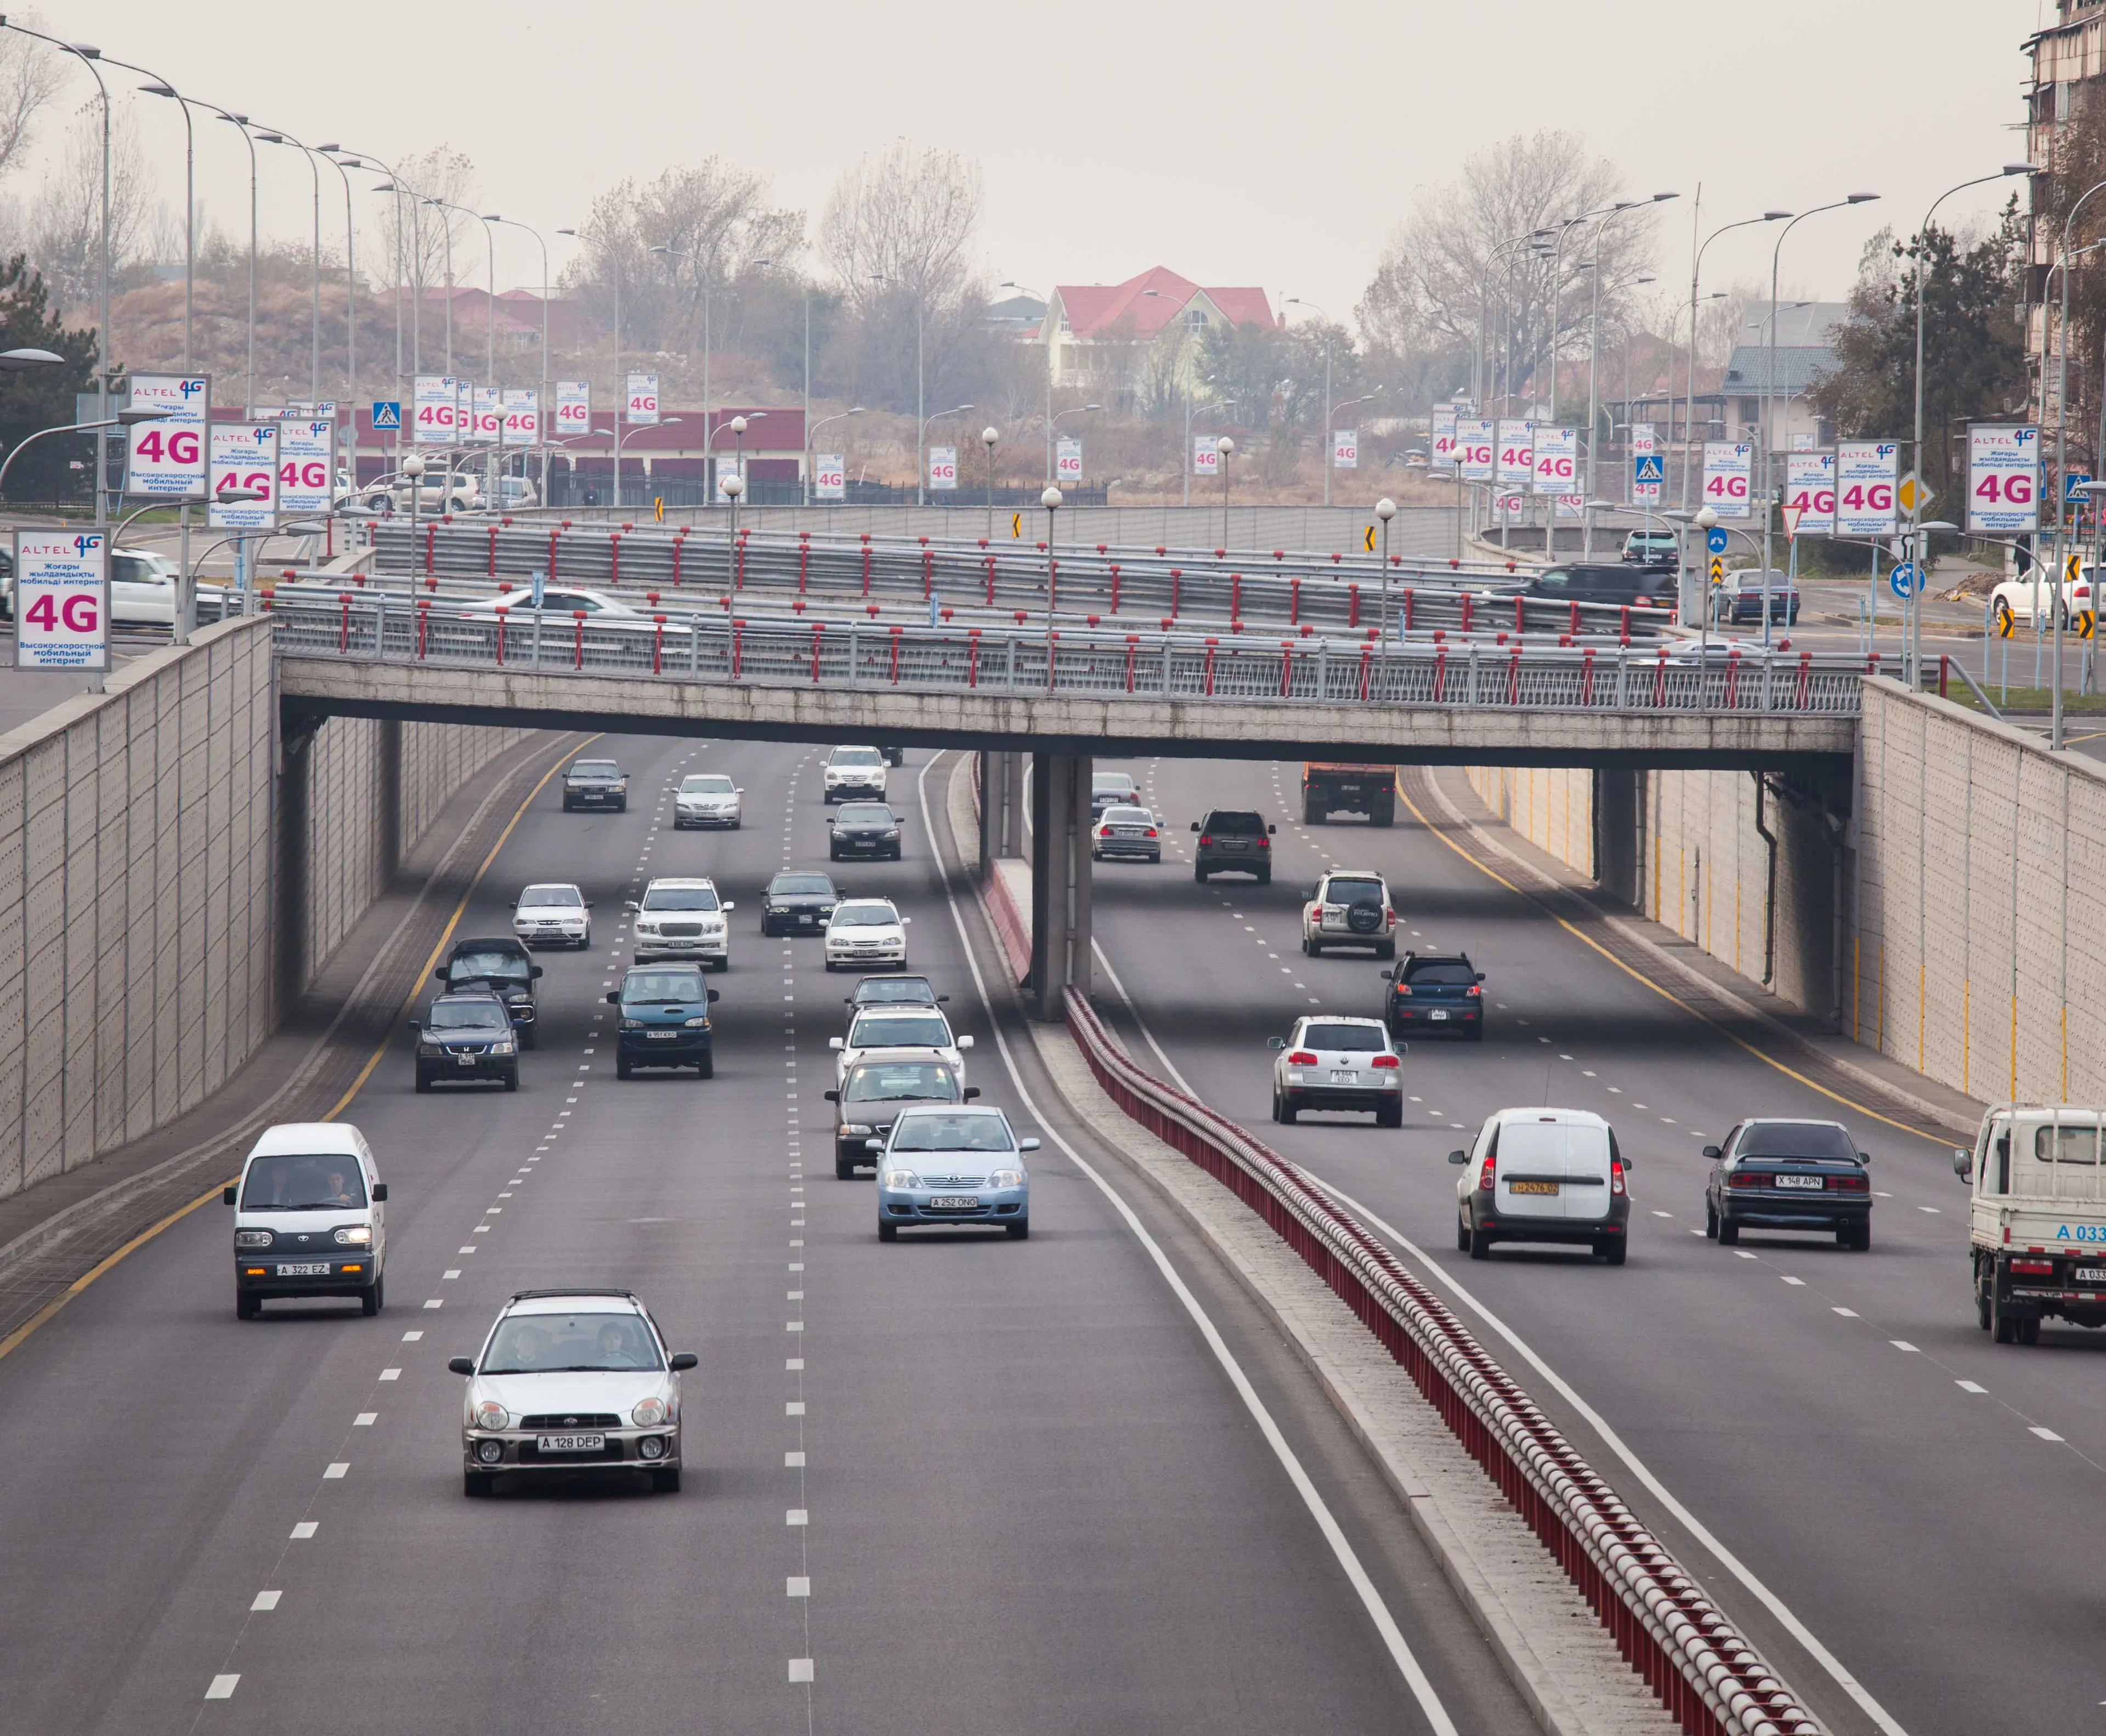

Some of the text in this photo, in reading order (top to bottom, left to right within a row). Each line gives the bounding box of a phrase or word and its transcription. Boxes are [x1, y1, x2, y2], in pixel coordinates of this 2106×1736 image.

[179, 380, 205, 400] 4G
[441, 378, 456, 389] 4G
[318, 403, 334, 415] 4G
[631, 397, 656, 410] 4G
[418, 406, 453, 425] 4G
[458, 410, 468, 427] G
[559, 405, 586, 419] 4G
[506, 415, 535, 430] 4G
[253, 428, 275, 445] 4G
[1561, 430, 1575, 441] 4G
[2014, 430, 2036, 447] 4G
[137, 431, 199, 464] 4G
[1436, 438, 1454, 452] 4
[1635, 440, 1652, 450] 4G
[1196, 453, 1215, 464] 4G
[1337, 447, 1355, 458] 4G
[1502, 449, 1532, 466] 4G
[1876, 445, 1895, 460] 4G
[1059, 458, 1080, 470] 4G
[1537, 458, 1572, 477] 4G
[932, 466, 954, 478] 4G
[216, 472, 270, 501] 4G
[819, 473, 841, 486] 4G
[1976, 475, 2031, 503] 4G
[1843, 484, 1891, 510] 4G
[73, 535, 103, 558] 4G
[26, 594, 97, 633] 4G
[19, 642, 105, 650] Высокоскоростной
[1779, 1176, 1784, 1184] X
[1803, 1177, 1820, 1185] APN
[2057, 1225, 2106, 1241] A 033
[281, 1265, 325, 1274] A 322 EZ
[2079, 1270, 2106, 1279] A 033
[542, 1437, 601, 1449] A 128 DEP
